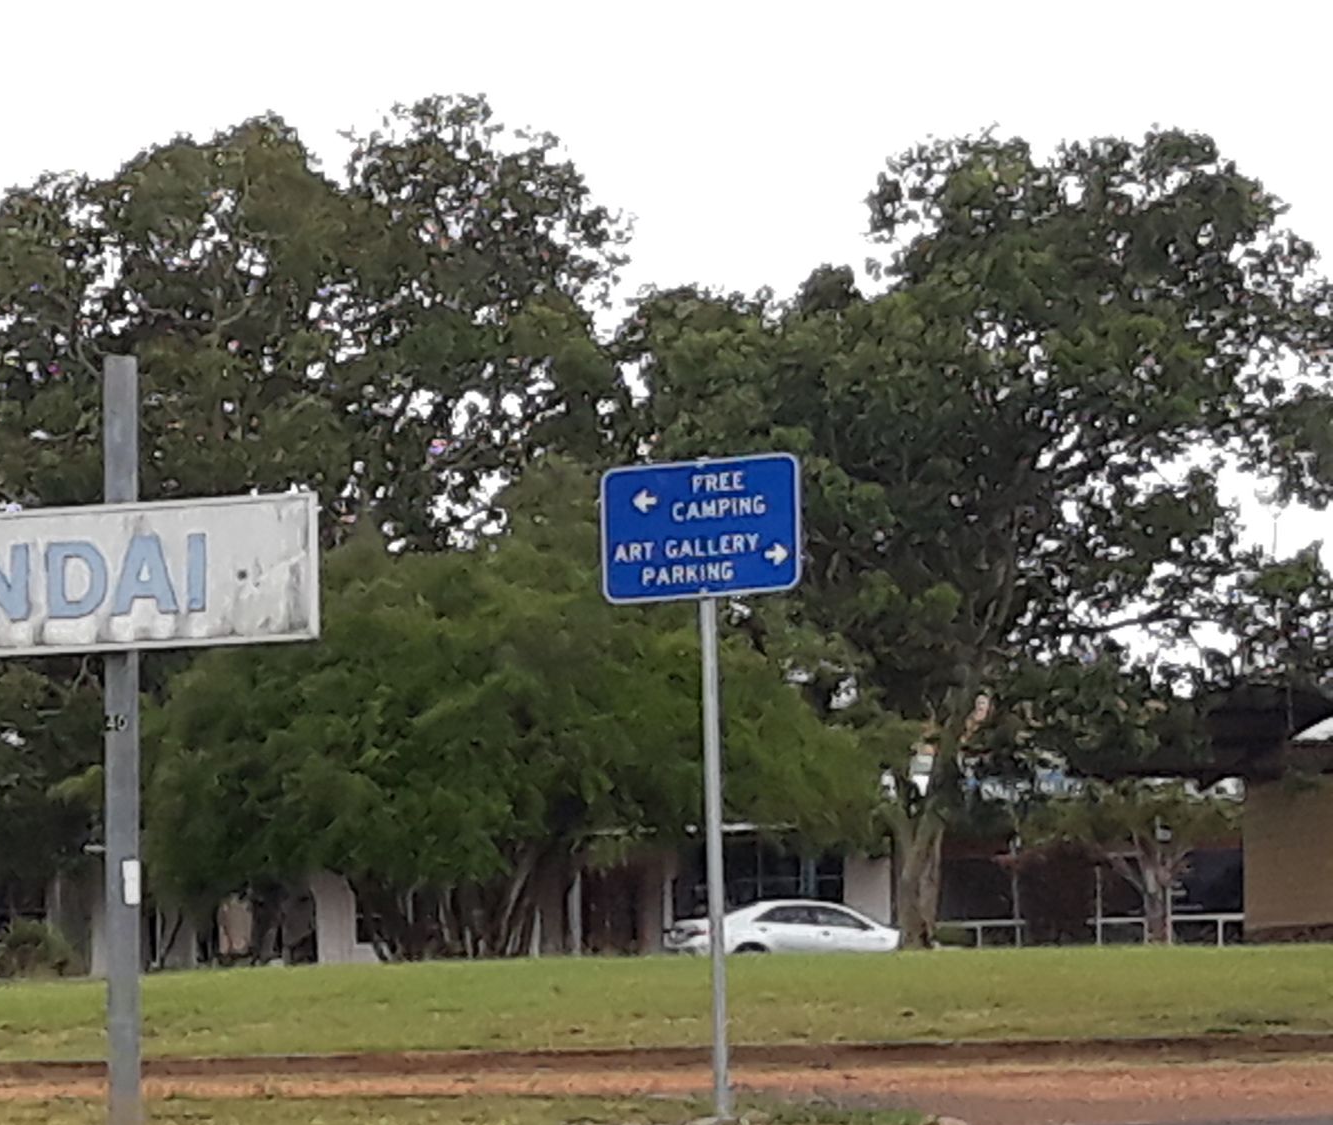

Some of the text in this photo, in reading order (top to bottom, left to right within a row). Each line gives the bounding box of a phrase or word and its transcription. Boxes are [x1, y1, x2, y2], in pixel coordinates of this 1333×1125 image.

[692, 471, 745, 493] FREE
[672, 495, 766, 522] CAMPING
[614, 533, 759, 563] ART GALLERY
[642, 562, 734, 586] PARKING
